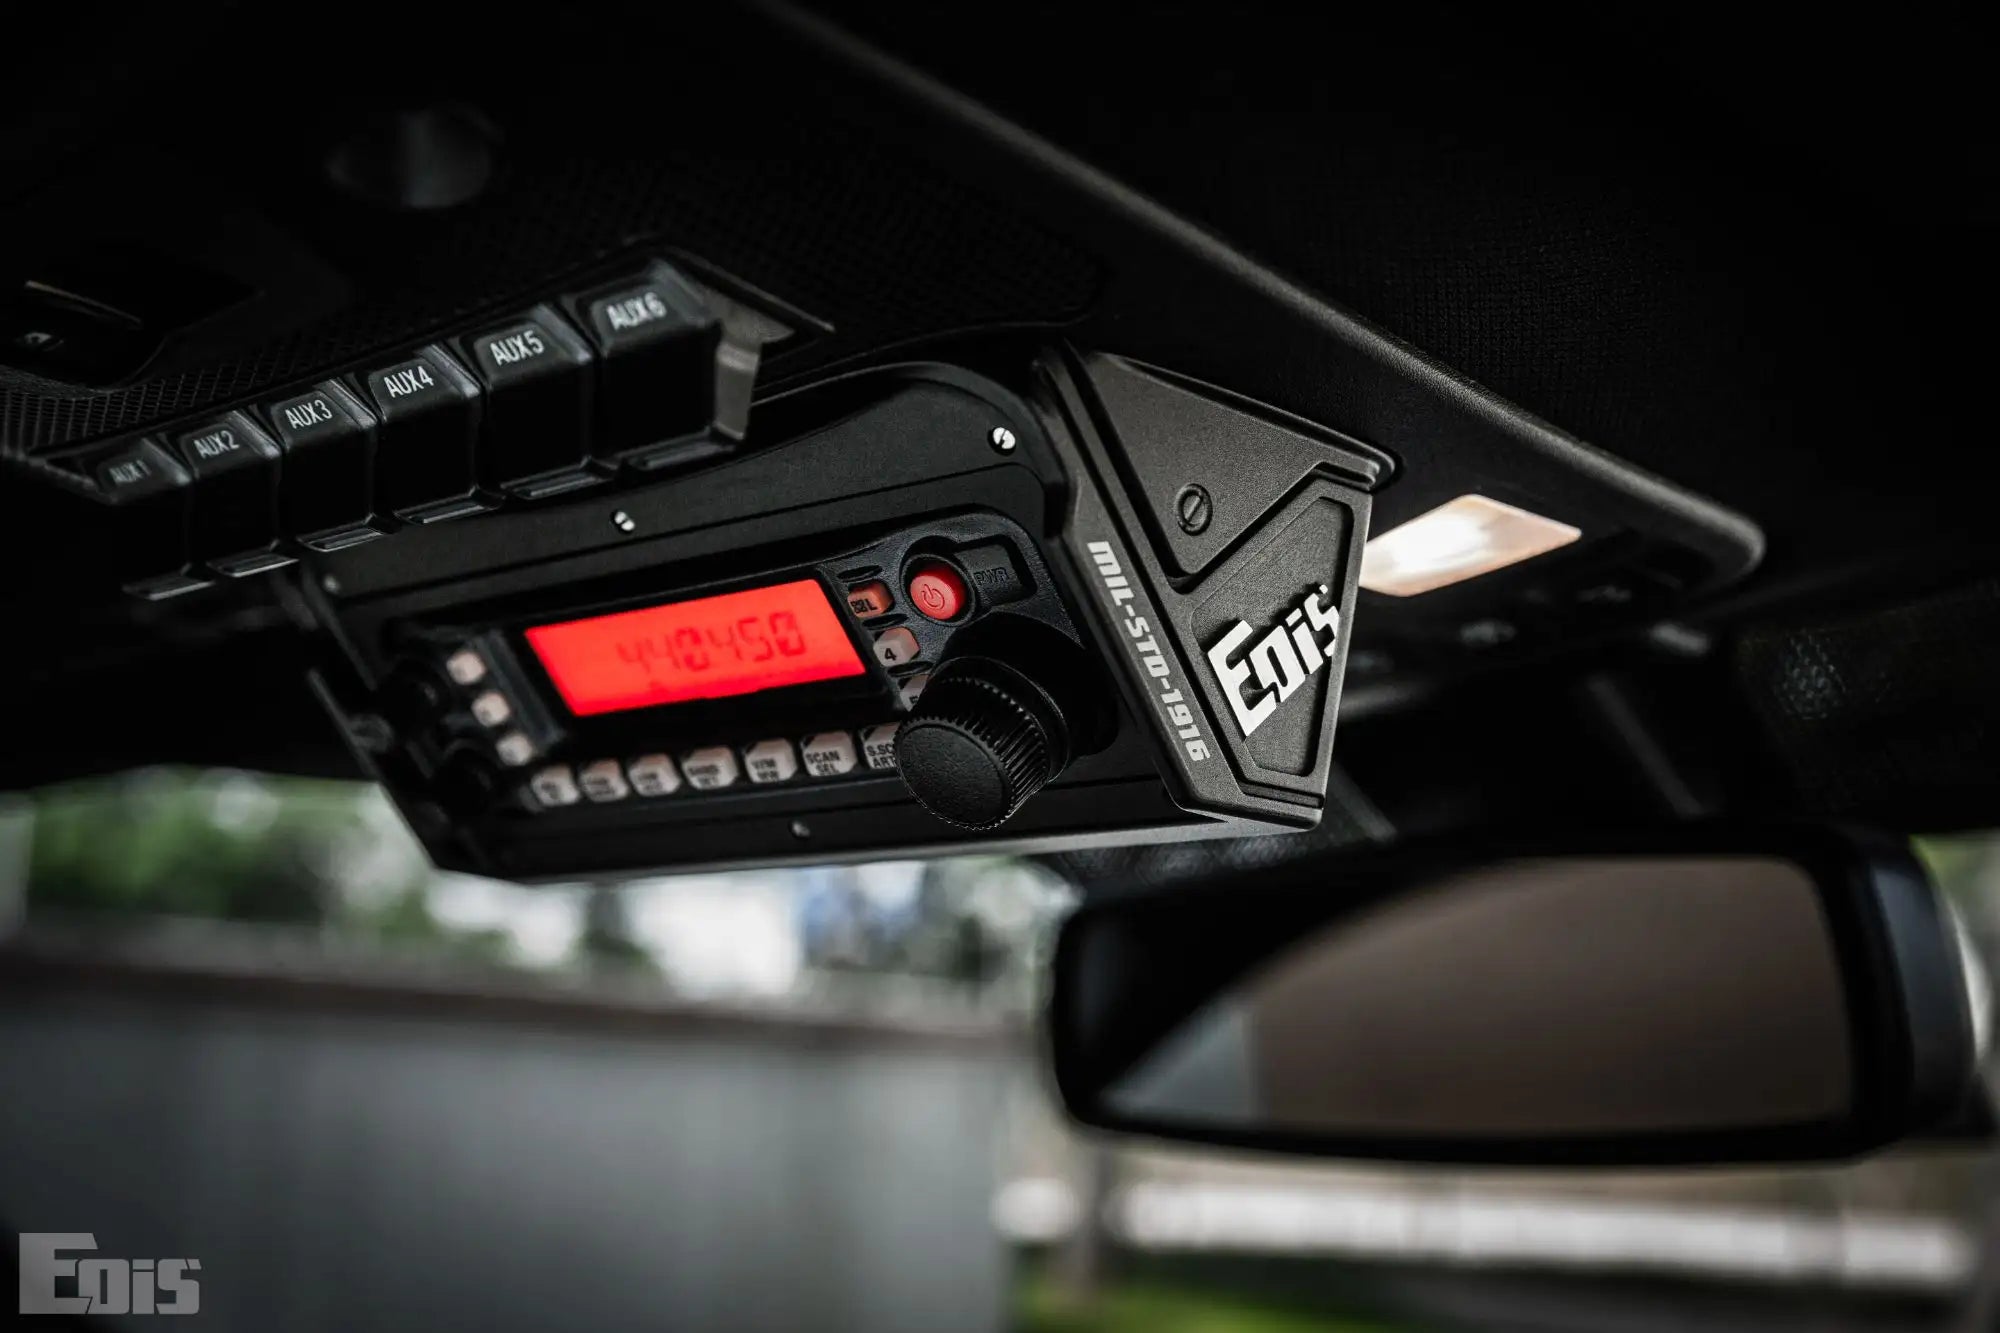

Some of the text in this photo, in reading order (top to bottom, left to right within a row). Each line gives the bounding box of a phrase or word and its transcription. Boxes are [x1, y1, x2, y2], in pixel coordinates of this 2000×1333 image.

[973, 566, 1010, 586] PWR
[883, 647, 897, 662] 4
[1086, 540, 1211, 762] MIL-STD-1916
[804, 750, 841, 765] SCAN
[866, 743, 895, 757] S.SC
[872, 755, 896, 768] ART
